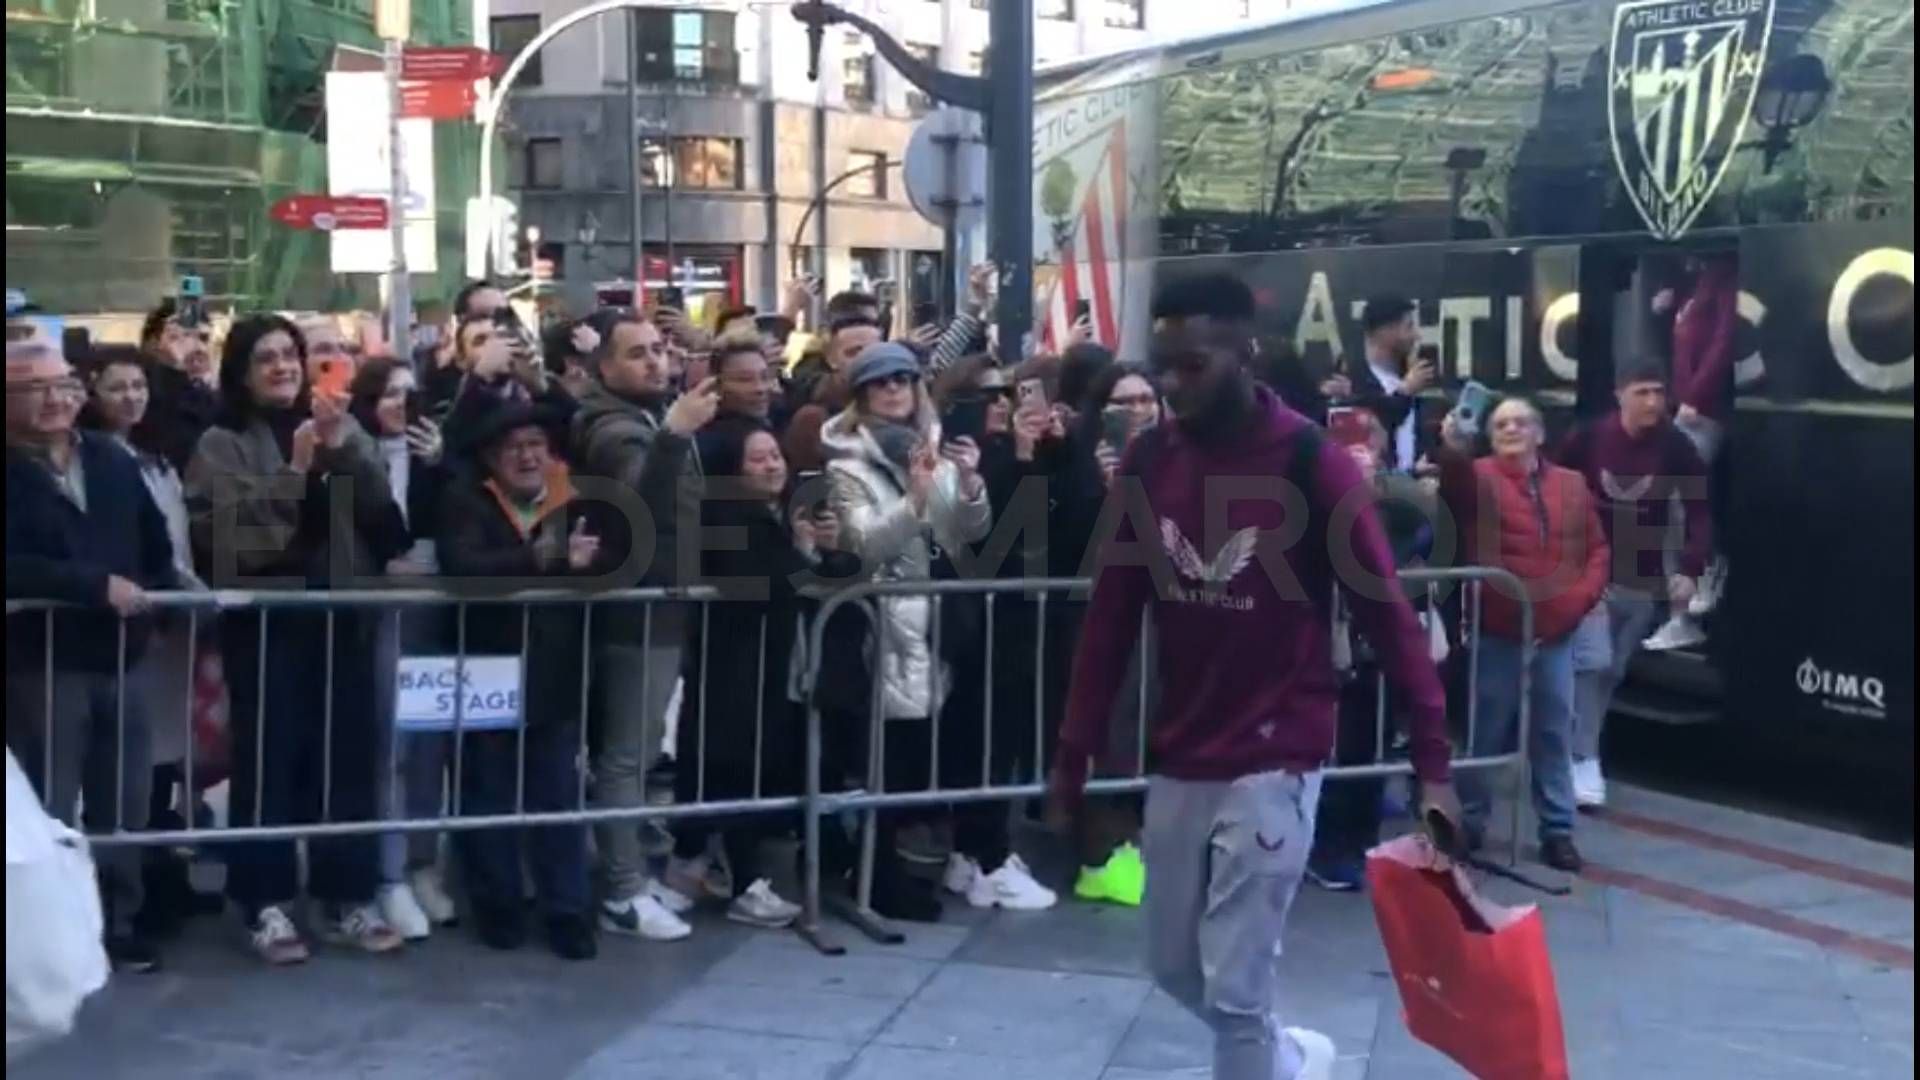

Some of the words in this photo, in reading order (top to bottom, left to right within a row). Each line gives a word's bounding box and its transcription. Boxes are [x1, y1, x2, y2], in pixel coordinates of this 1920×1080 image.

[1625, 2, 1707, 28] ATHLETIC
[1639, 164, 1707, 236] BILBAO
[399, 669, 473, 691] BACK
[1822, 669, 1886, 708] IMQ
